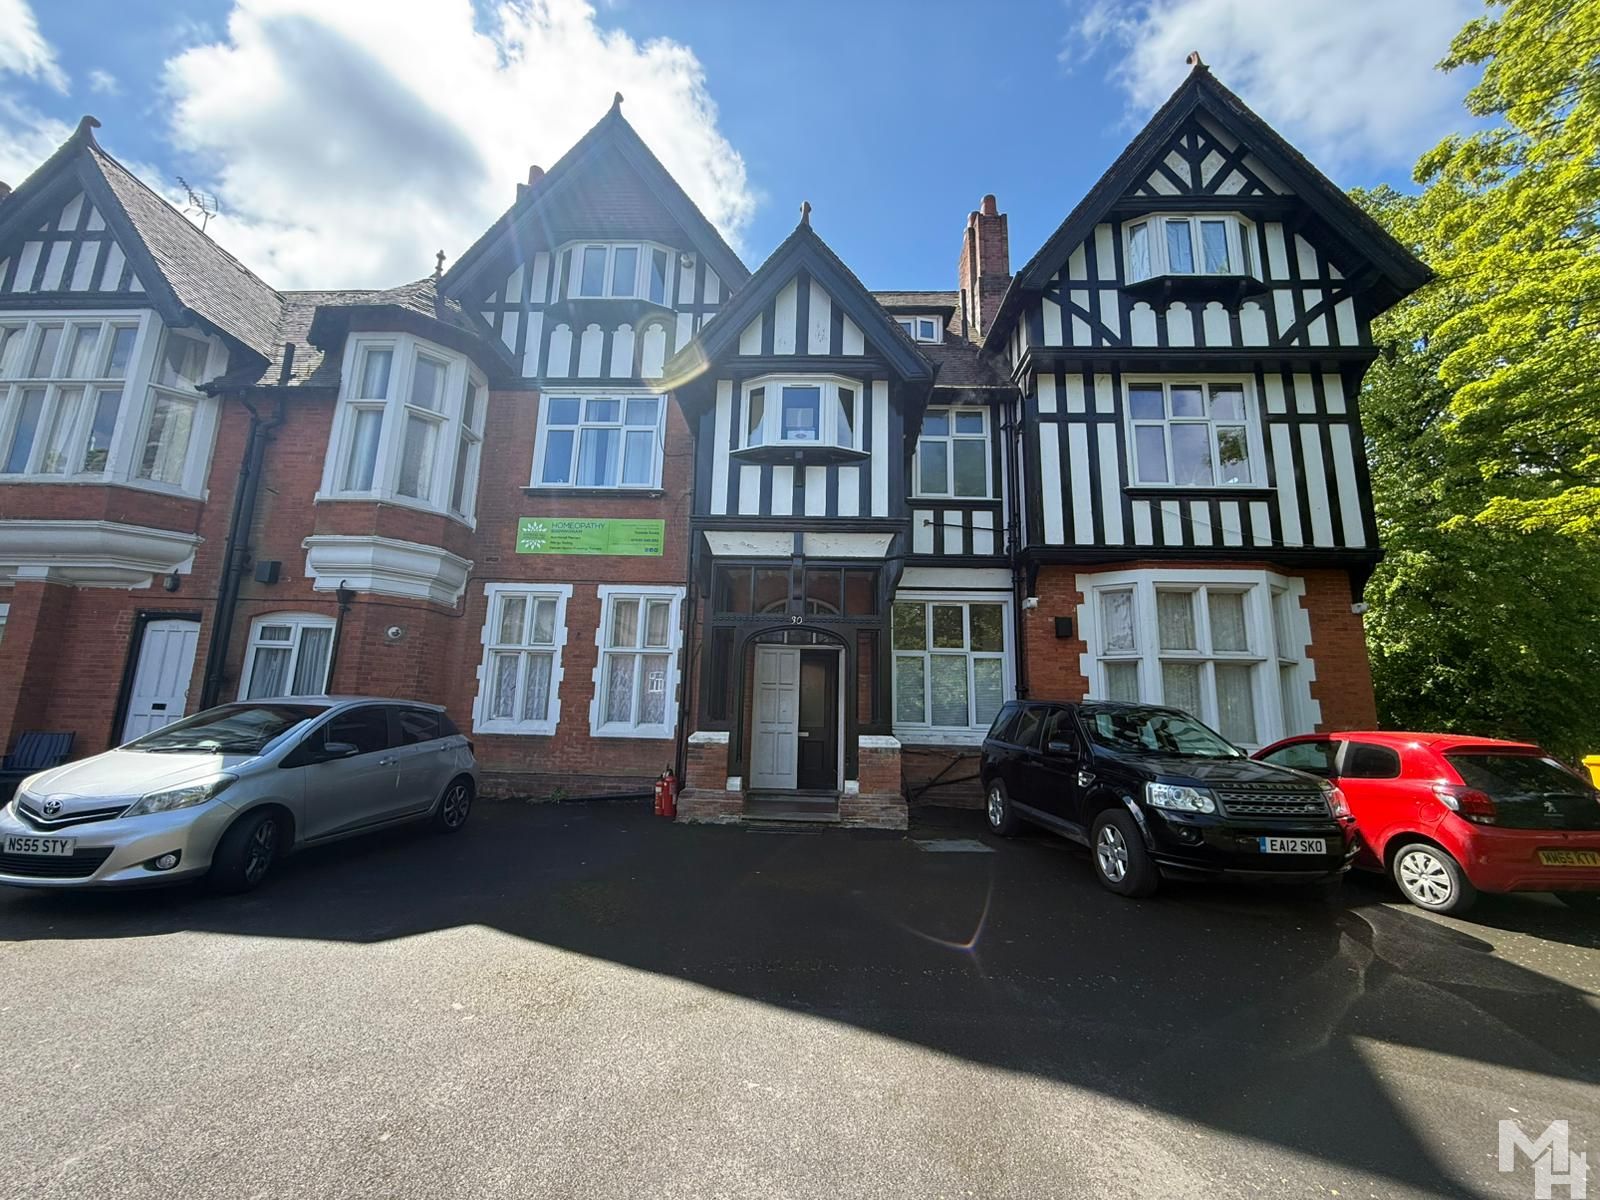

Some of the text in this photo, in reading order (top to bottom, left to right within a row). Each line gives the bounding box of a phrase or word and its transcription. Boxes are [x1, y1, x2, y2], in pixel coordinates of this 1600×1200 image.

[551, 521, 605, 529] HOMEOPATHY
[791, 616, 803, 624] 30
[8, 837, 68, 854] NS55 STY
[1270, 839, 1297, 852] EA12
[1300, 840, 1323, 852] SKO
